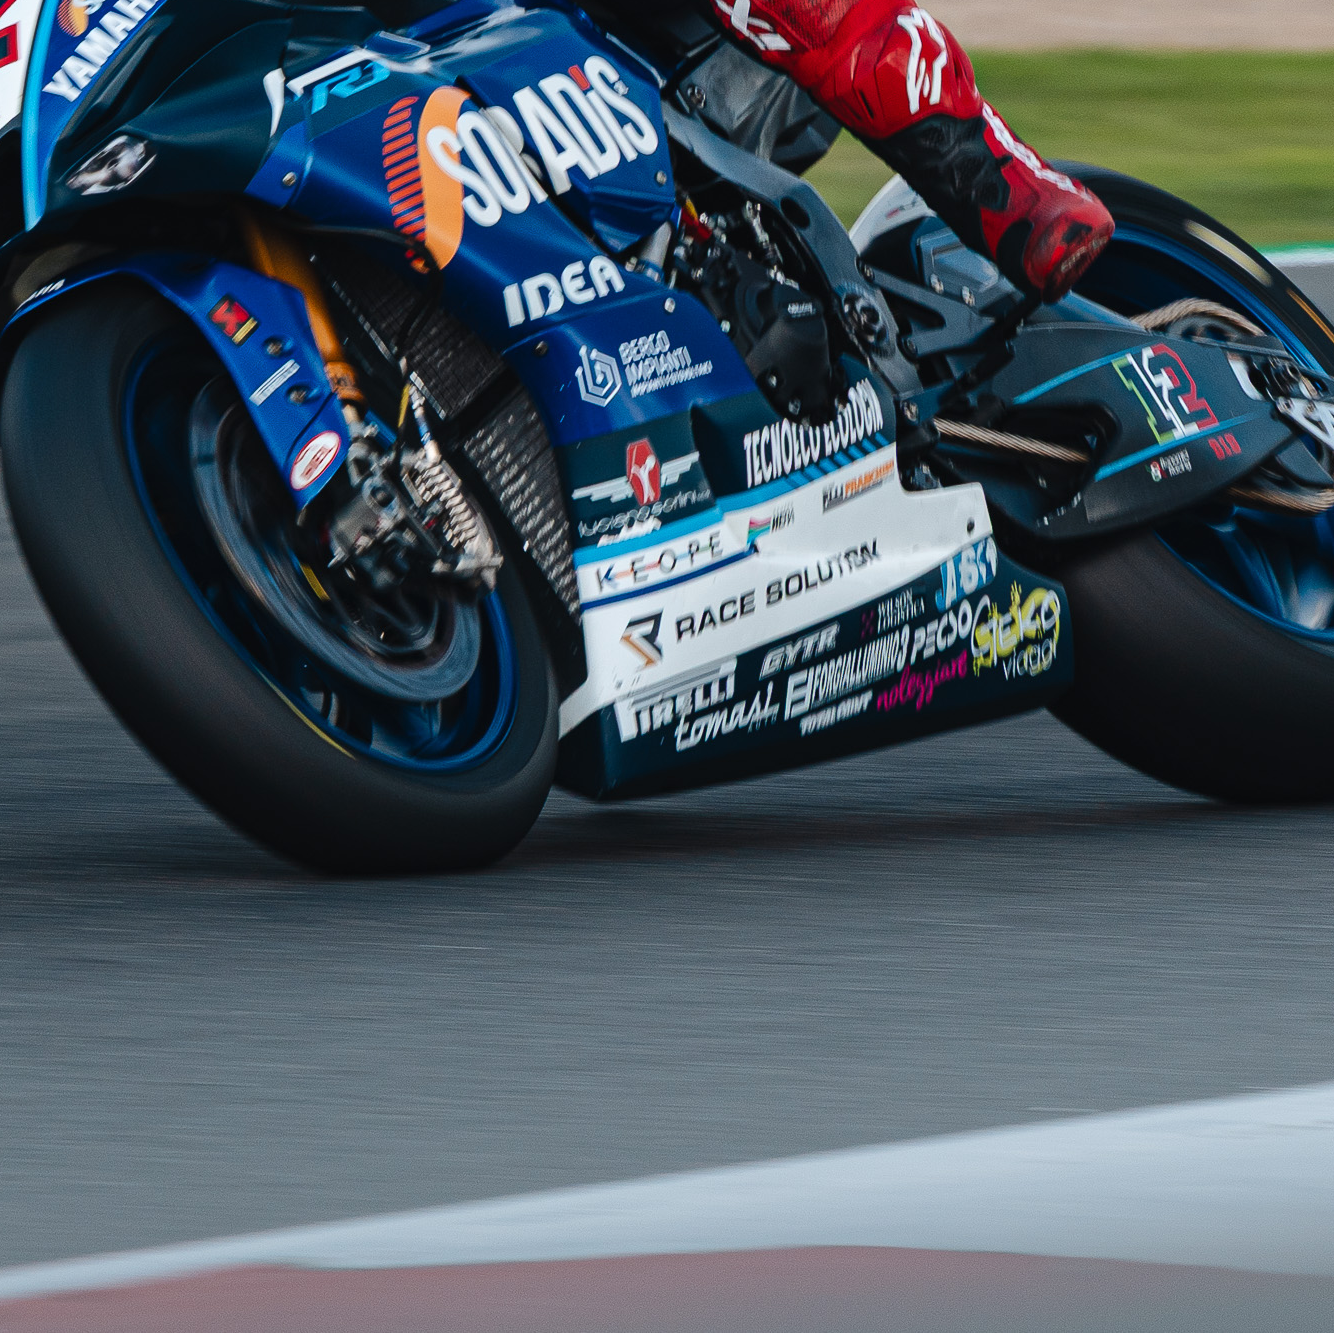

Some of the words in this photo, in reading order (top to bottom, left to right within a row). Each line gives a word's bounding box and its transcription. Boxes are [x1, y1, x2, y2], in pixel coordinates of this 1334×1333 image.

[502, 255, 626, 329] IDEA
[1112, 342, 1219, 444] 12
[595, 529, 724, 593] KEOPE
[675, 584, 758, 643] RACE
[765, 536, 882, 606] SOLUTION
[759, 620, 841, 681] GYTR
[613, 657, 738, 743] PIRELLI
